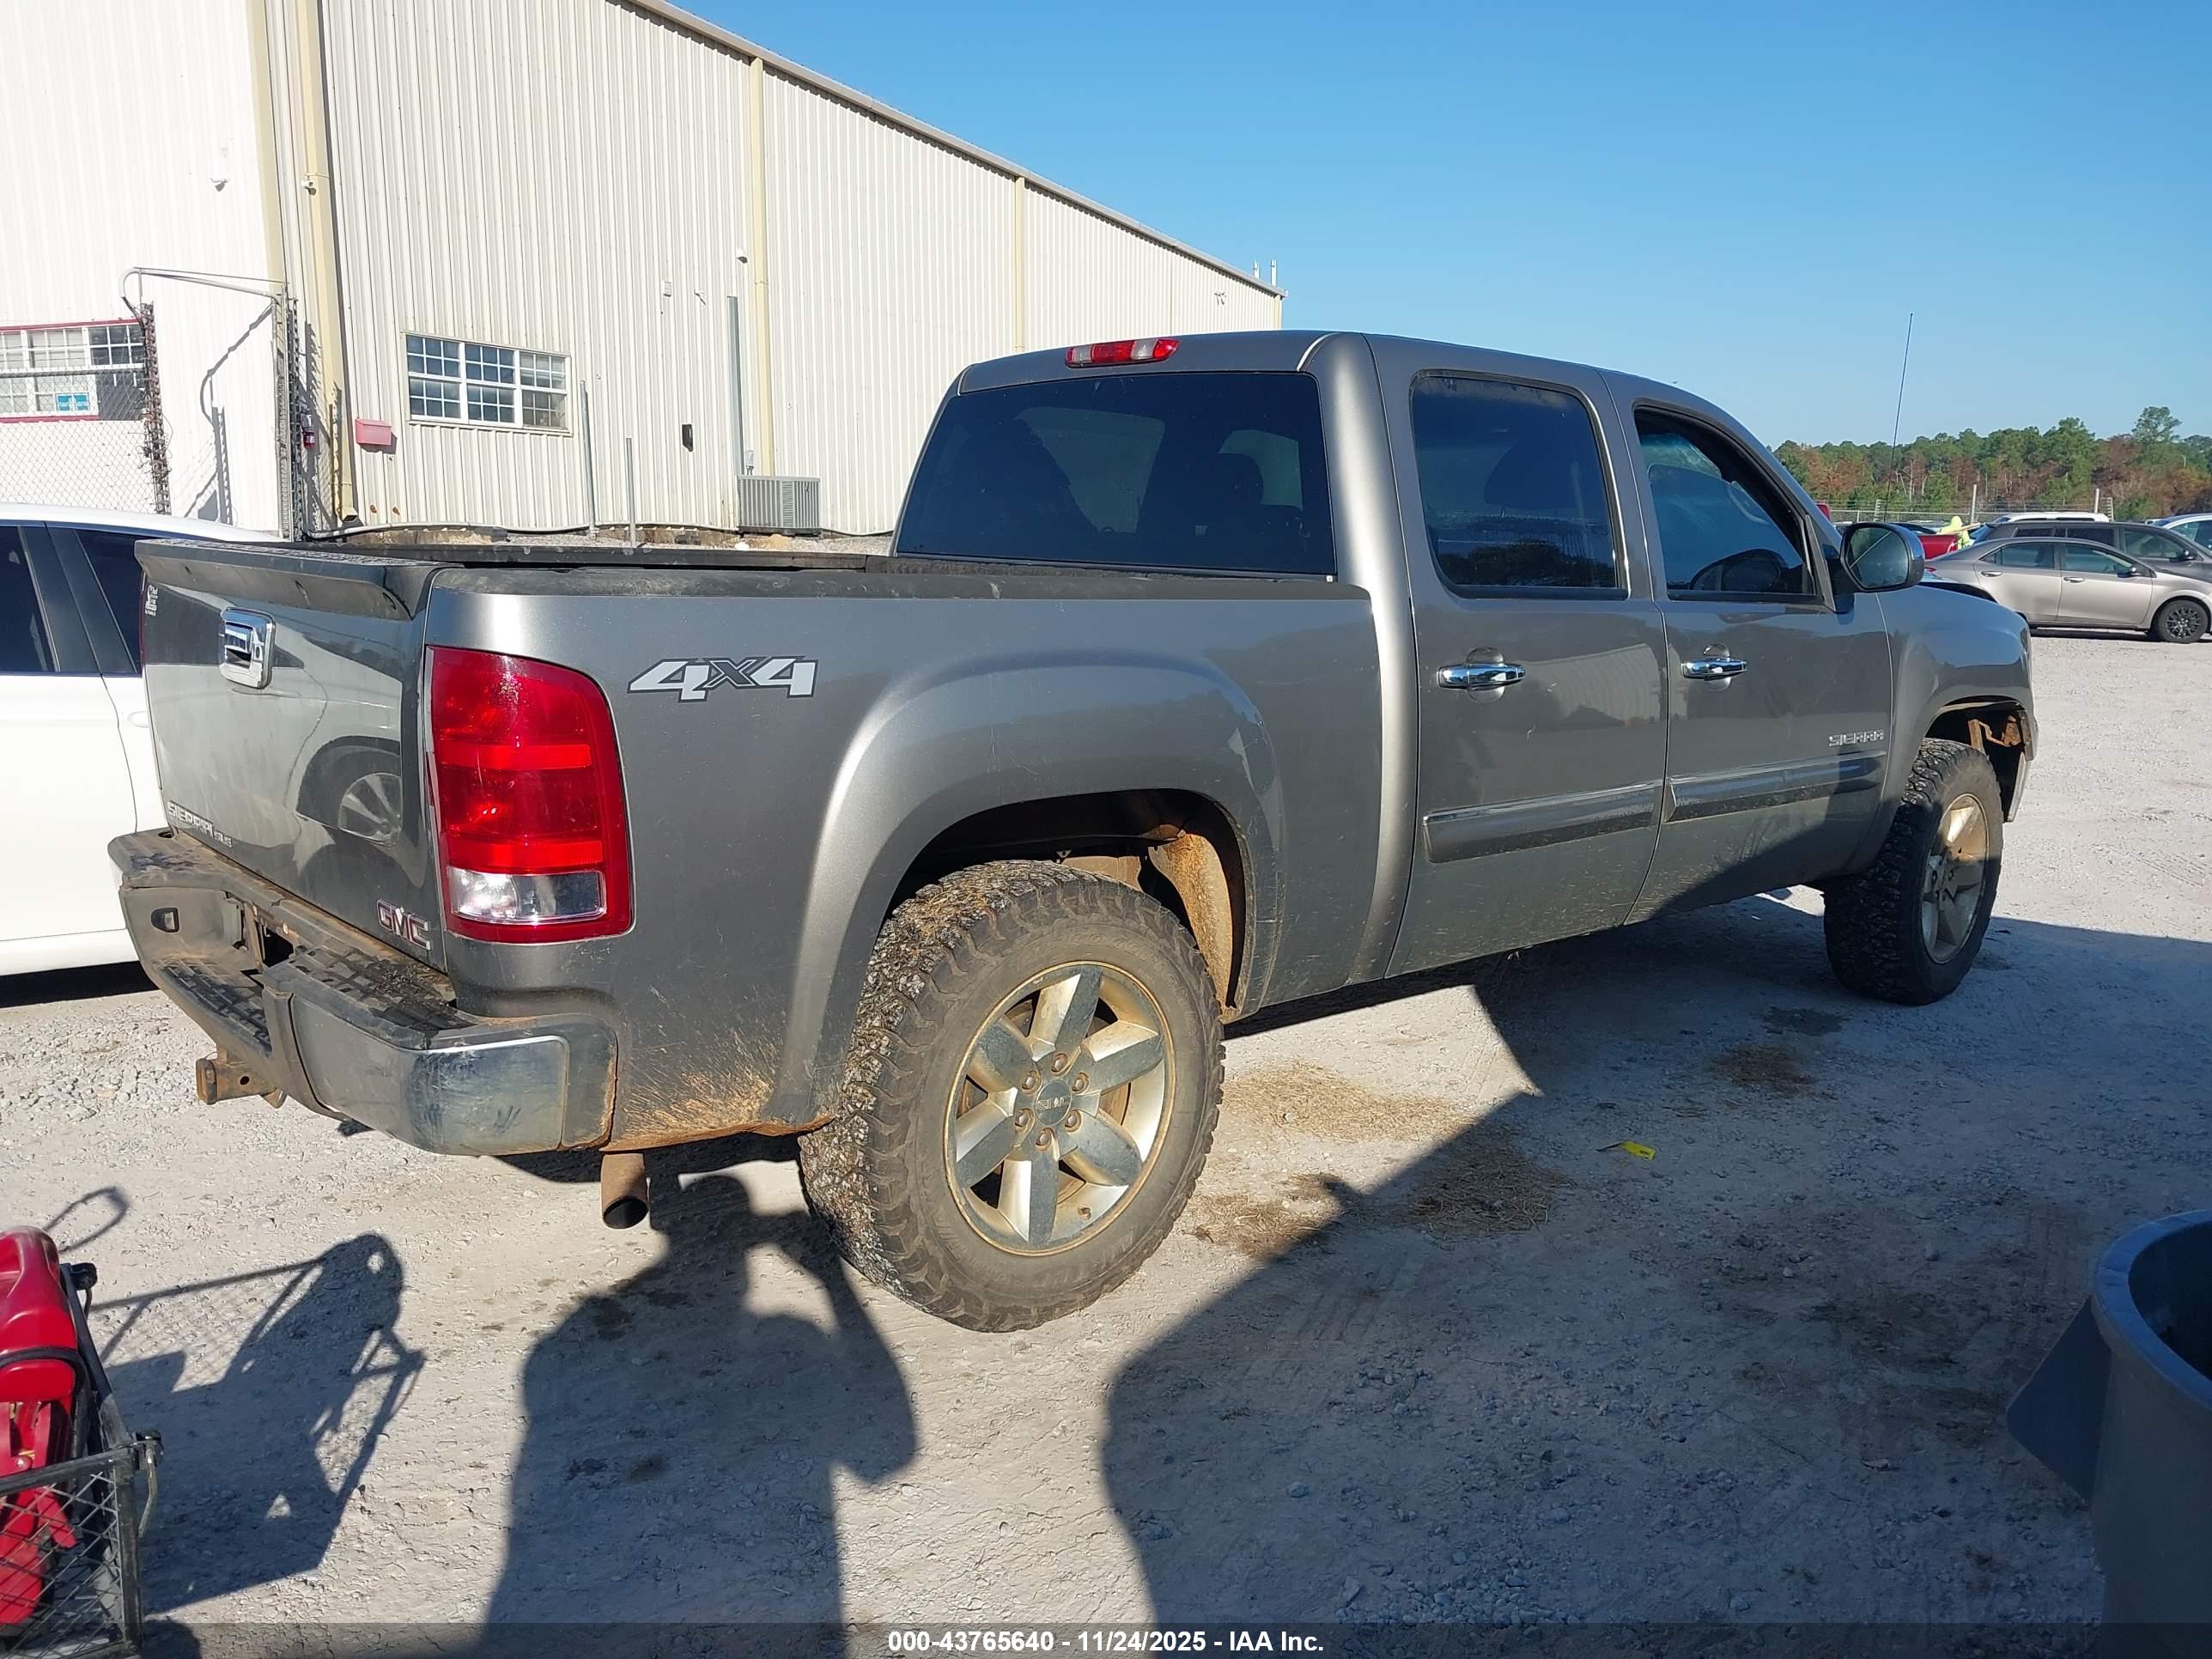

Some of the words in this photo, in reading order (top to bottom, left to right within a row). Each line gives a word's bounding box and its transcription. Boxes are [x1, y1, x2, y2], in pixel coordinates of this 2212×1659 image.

[1828, 729, 1883, 747] SIERRA
[167, 799, 214, 839] SIERRA
[377, 899, 432, 951] GMC
